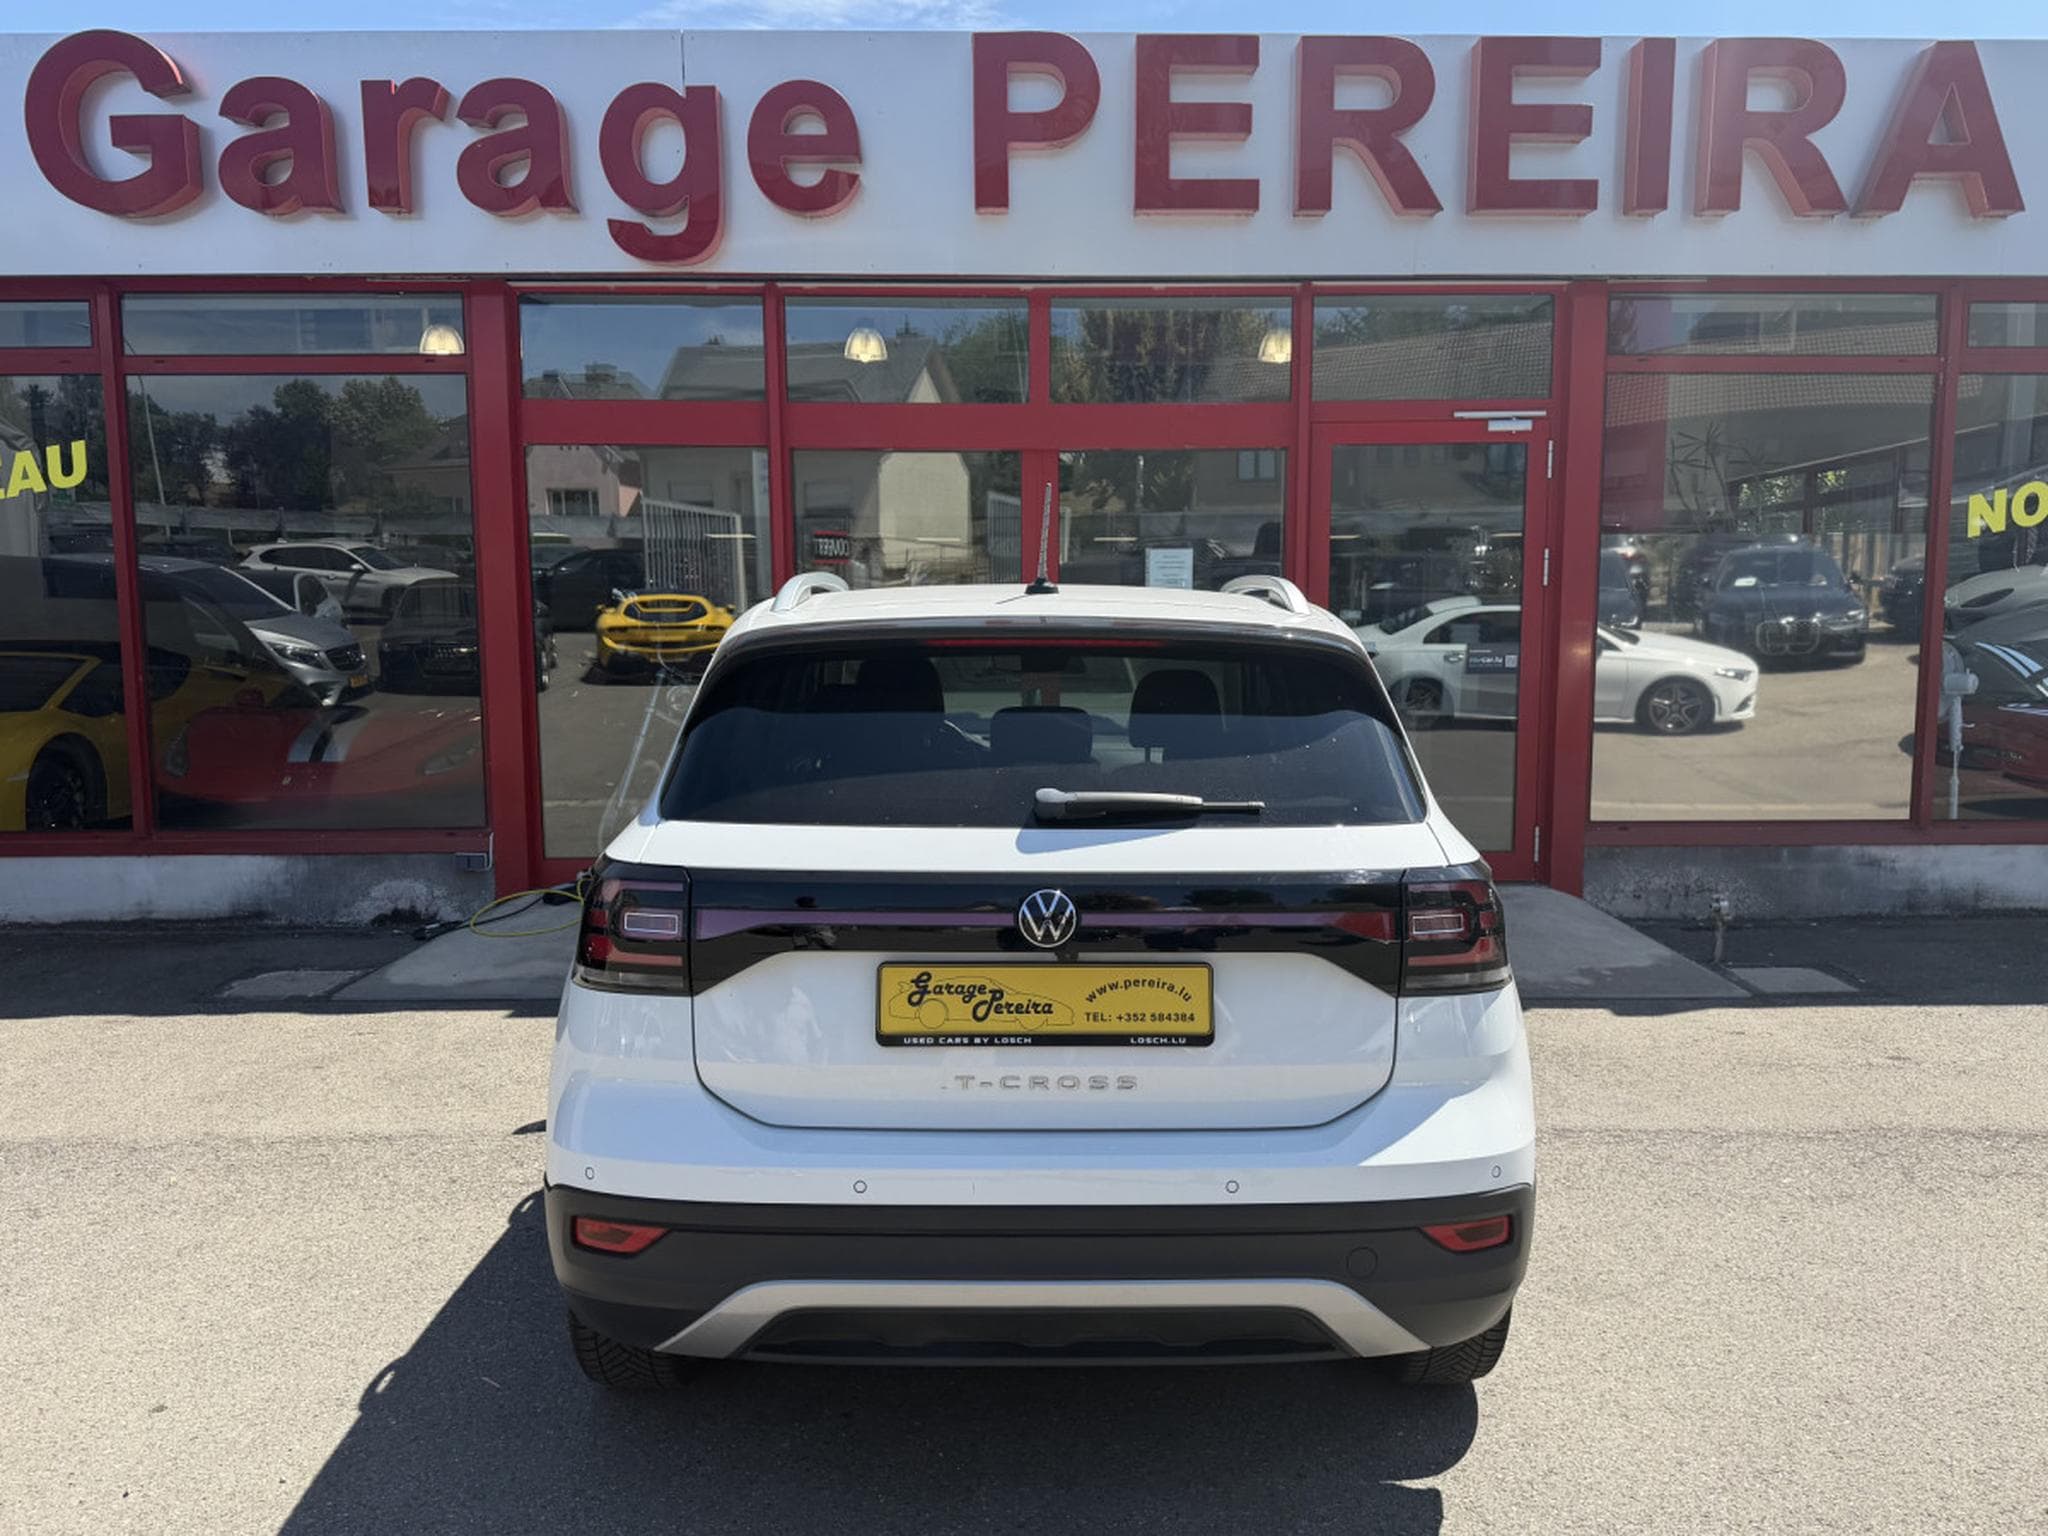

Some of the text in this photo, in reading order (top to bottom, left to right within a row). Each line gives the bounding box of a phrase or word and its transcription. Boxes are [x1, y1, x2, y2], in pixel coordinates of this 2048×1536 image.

[25, 29, 2026, 266] Garage PEREIRA
[1967, 481, 2048, 538] NO
[907, 971, 987, 1007] Garage
[1085, 978, 1192, 1003] www.pereira.lu
[972, 988, 1054, 1023] Pereira
[1085, 1012, 1196, 1022] TEL: +352 584384
[903, 1037, 1033, 1045] USED CARS BY LOSCH
[1129, 1037, 1187, 1045] LOSCH.LU
[955, 1075, 1139, 1091] T-CROSS
